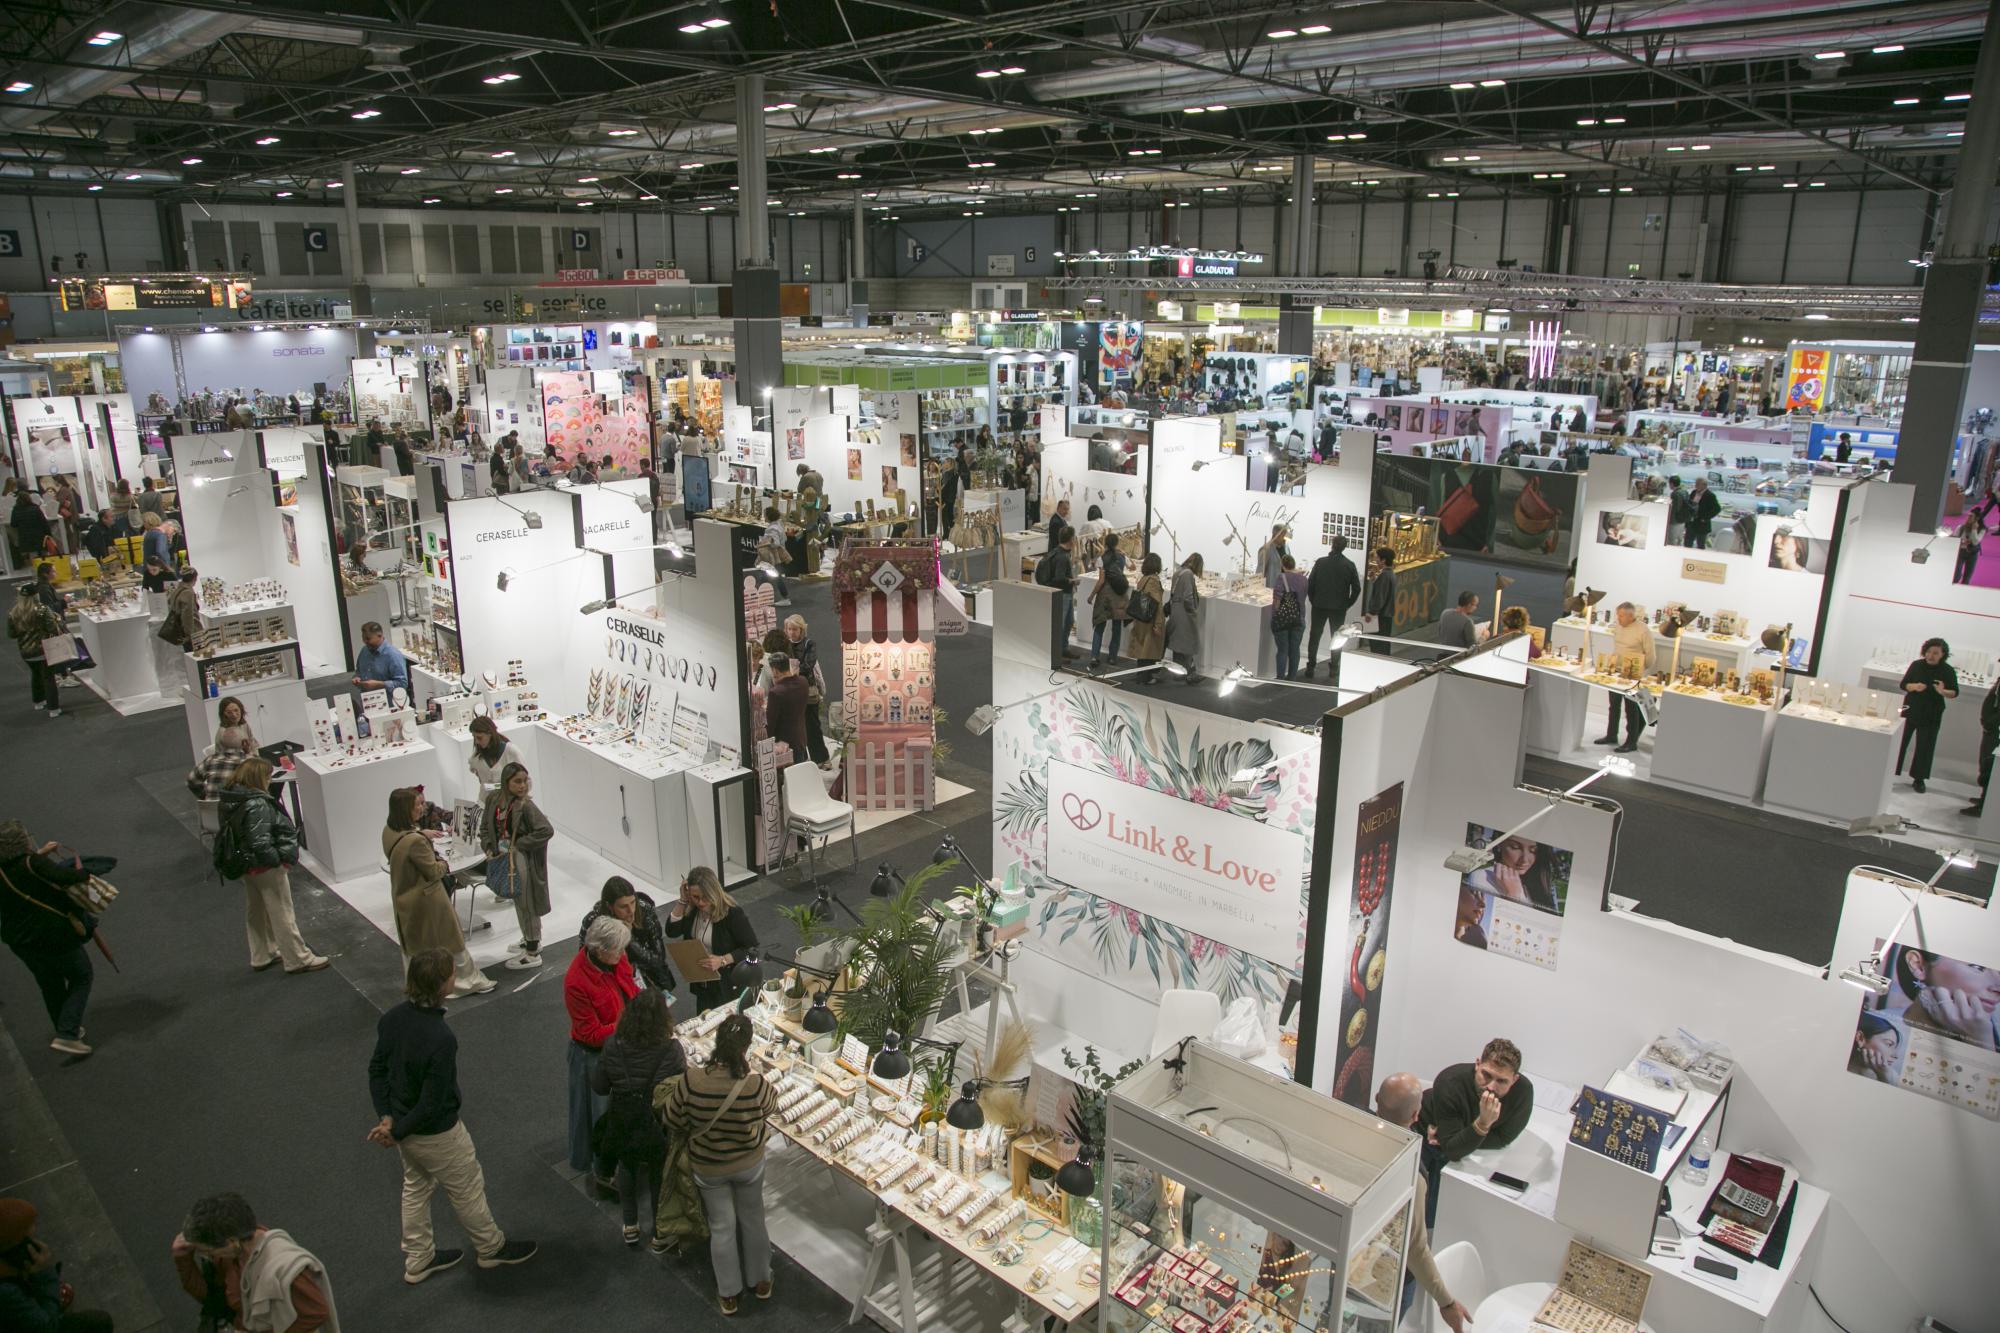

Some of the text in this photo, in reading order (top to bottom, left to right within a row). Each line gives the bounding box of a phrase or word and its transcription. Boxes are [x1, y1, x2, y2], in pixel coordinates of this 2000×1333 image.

[0, 234, 14, 254] B
[309, 232, 323, 249] C
[575, 233, 587, 248] D
[916, 248, 923, 260] F
[1026, 249, 1034, 260] G
[1195, 265, 1235, 275] GLADIATOR
[272, 347, 325, 357] sonata
[581, 520, 631, 535] NACARELLE
[476, 528, 529, 543] CERASELLE
[606, 617, 666, 648] CERASELLE
[1360, 801, 1400, 837] NIEDDU
[1107, 812, 1276, 893] Link & Love
[1109, 864, 1140, 882] JEWELS
[1153, 879, 1193, 902] HANDMADE
[1198, 897, 1207, 907] IN
[1211, 900, 1256, 924] MARBELLA
